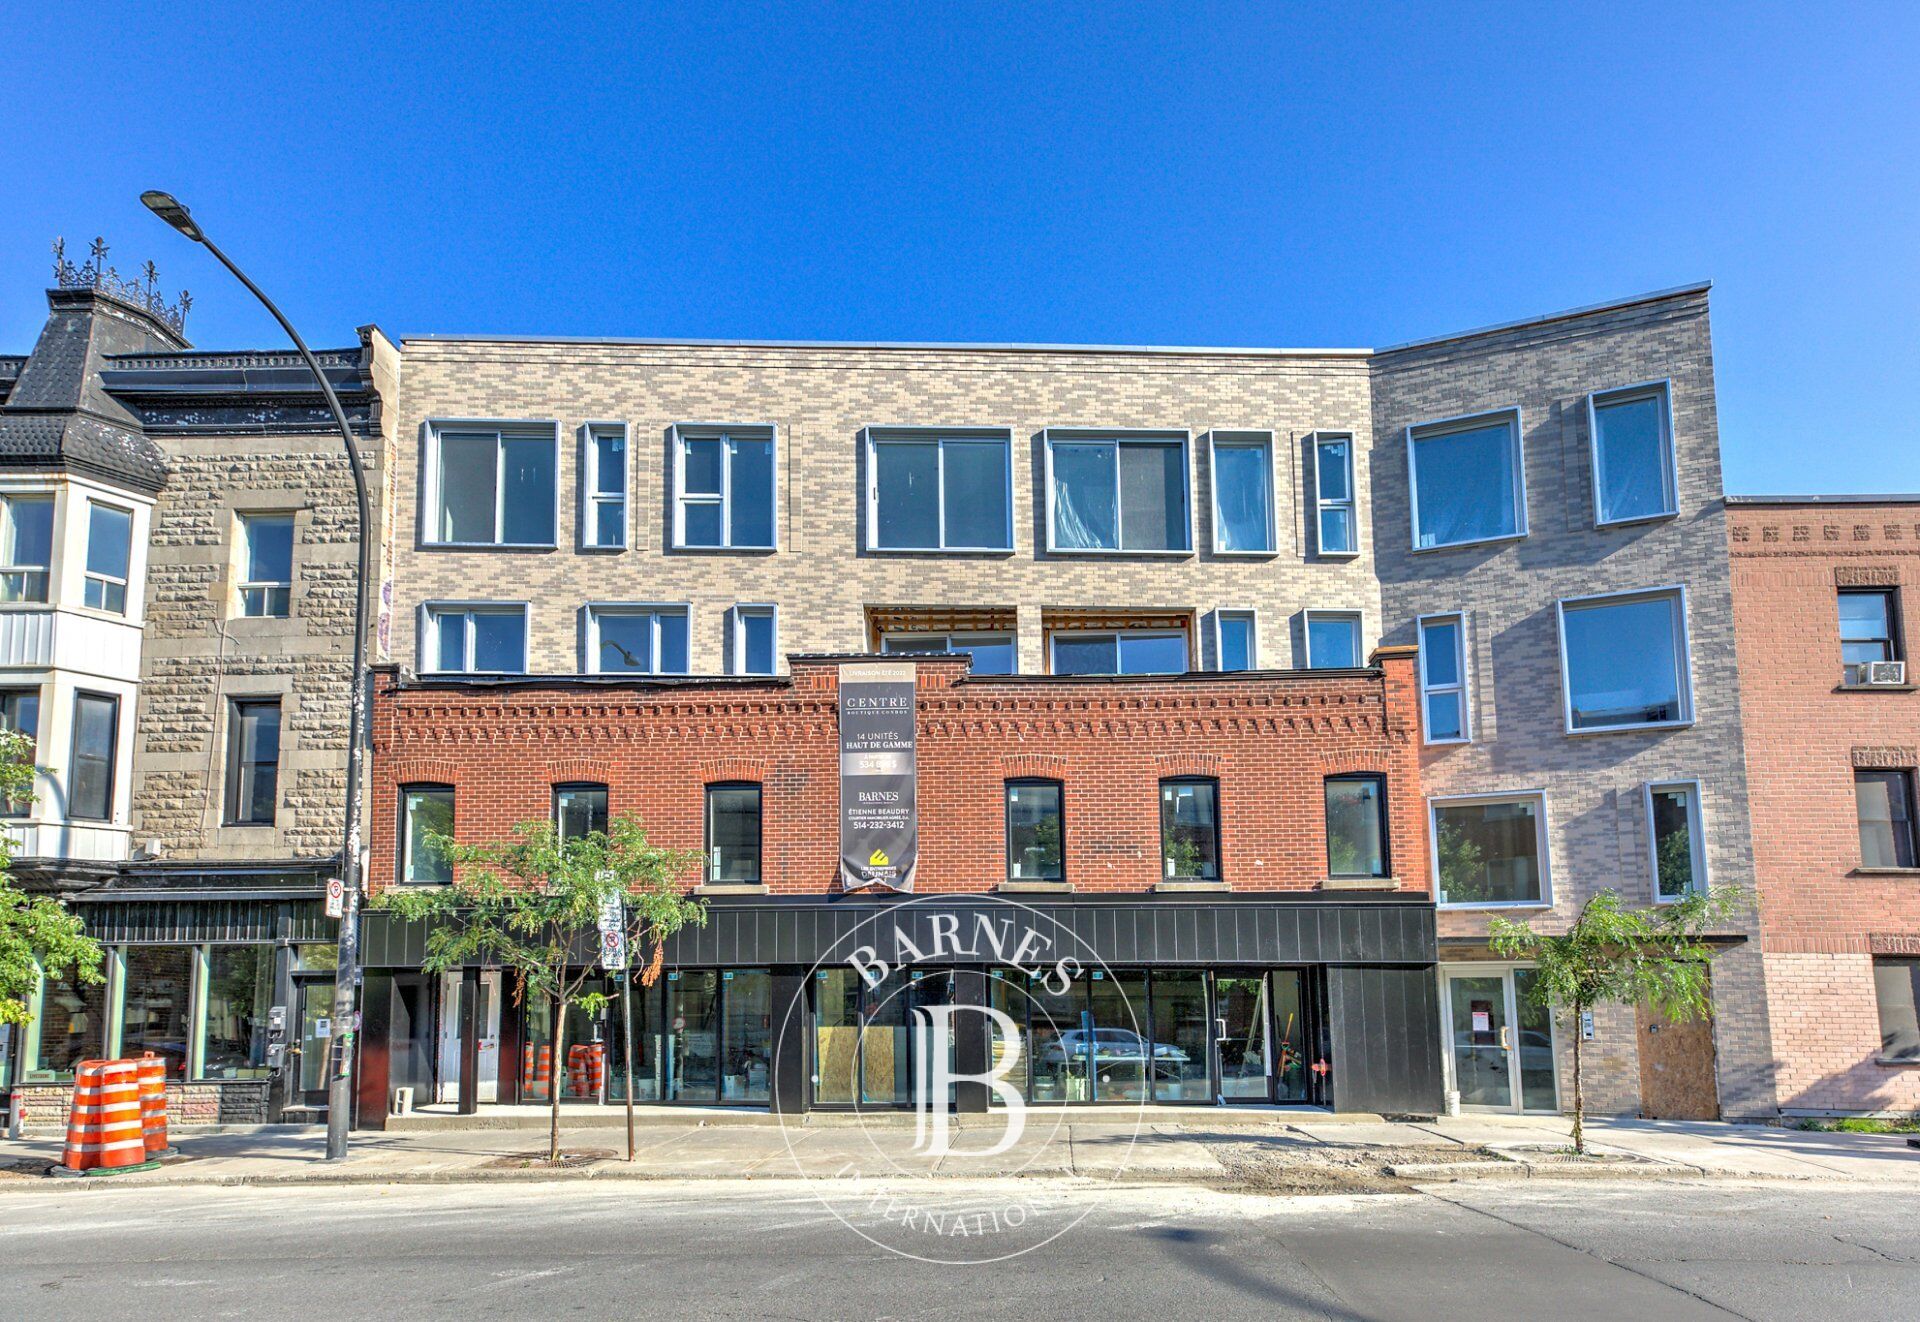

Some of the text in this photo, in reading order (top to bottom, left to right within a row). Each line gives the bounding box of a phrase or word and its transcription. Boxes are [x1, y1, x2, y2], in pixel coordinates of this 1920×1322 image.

[847, 697, 907, 707] CENTRE
[868, 731, 899, 740] UNITÉS
[882, 741, 913, 749] GAMME
[858, 791, 899, 801] BARNES
[853, 820, 904, 829] 514-232-3412
